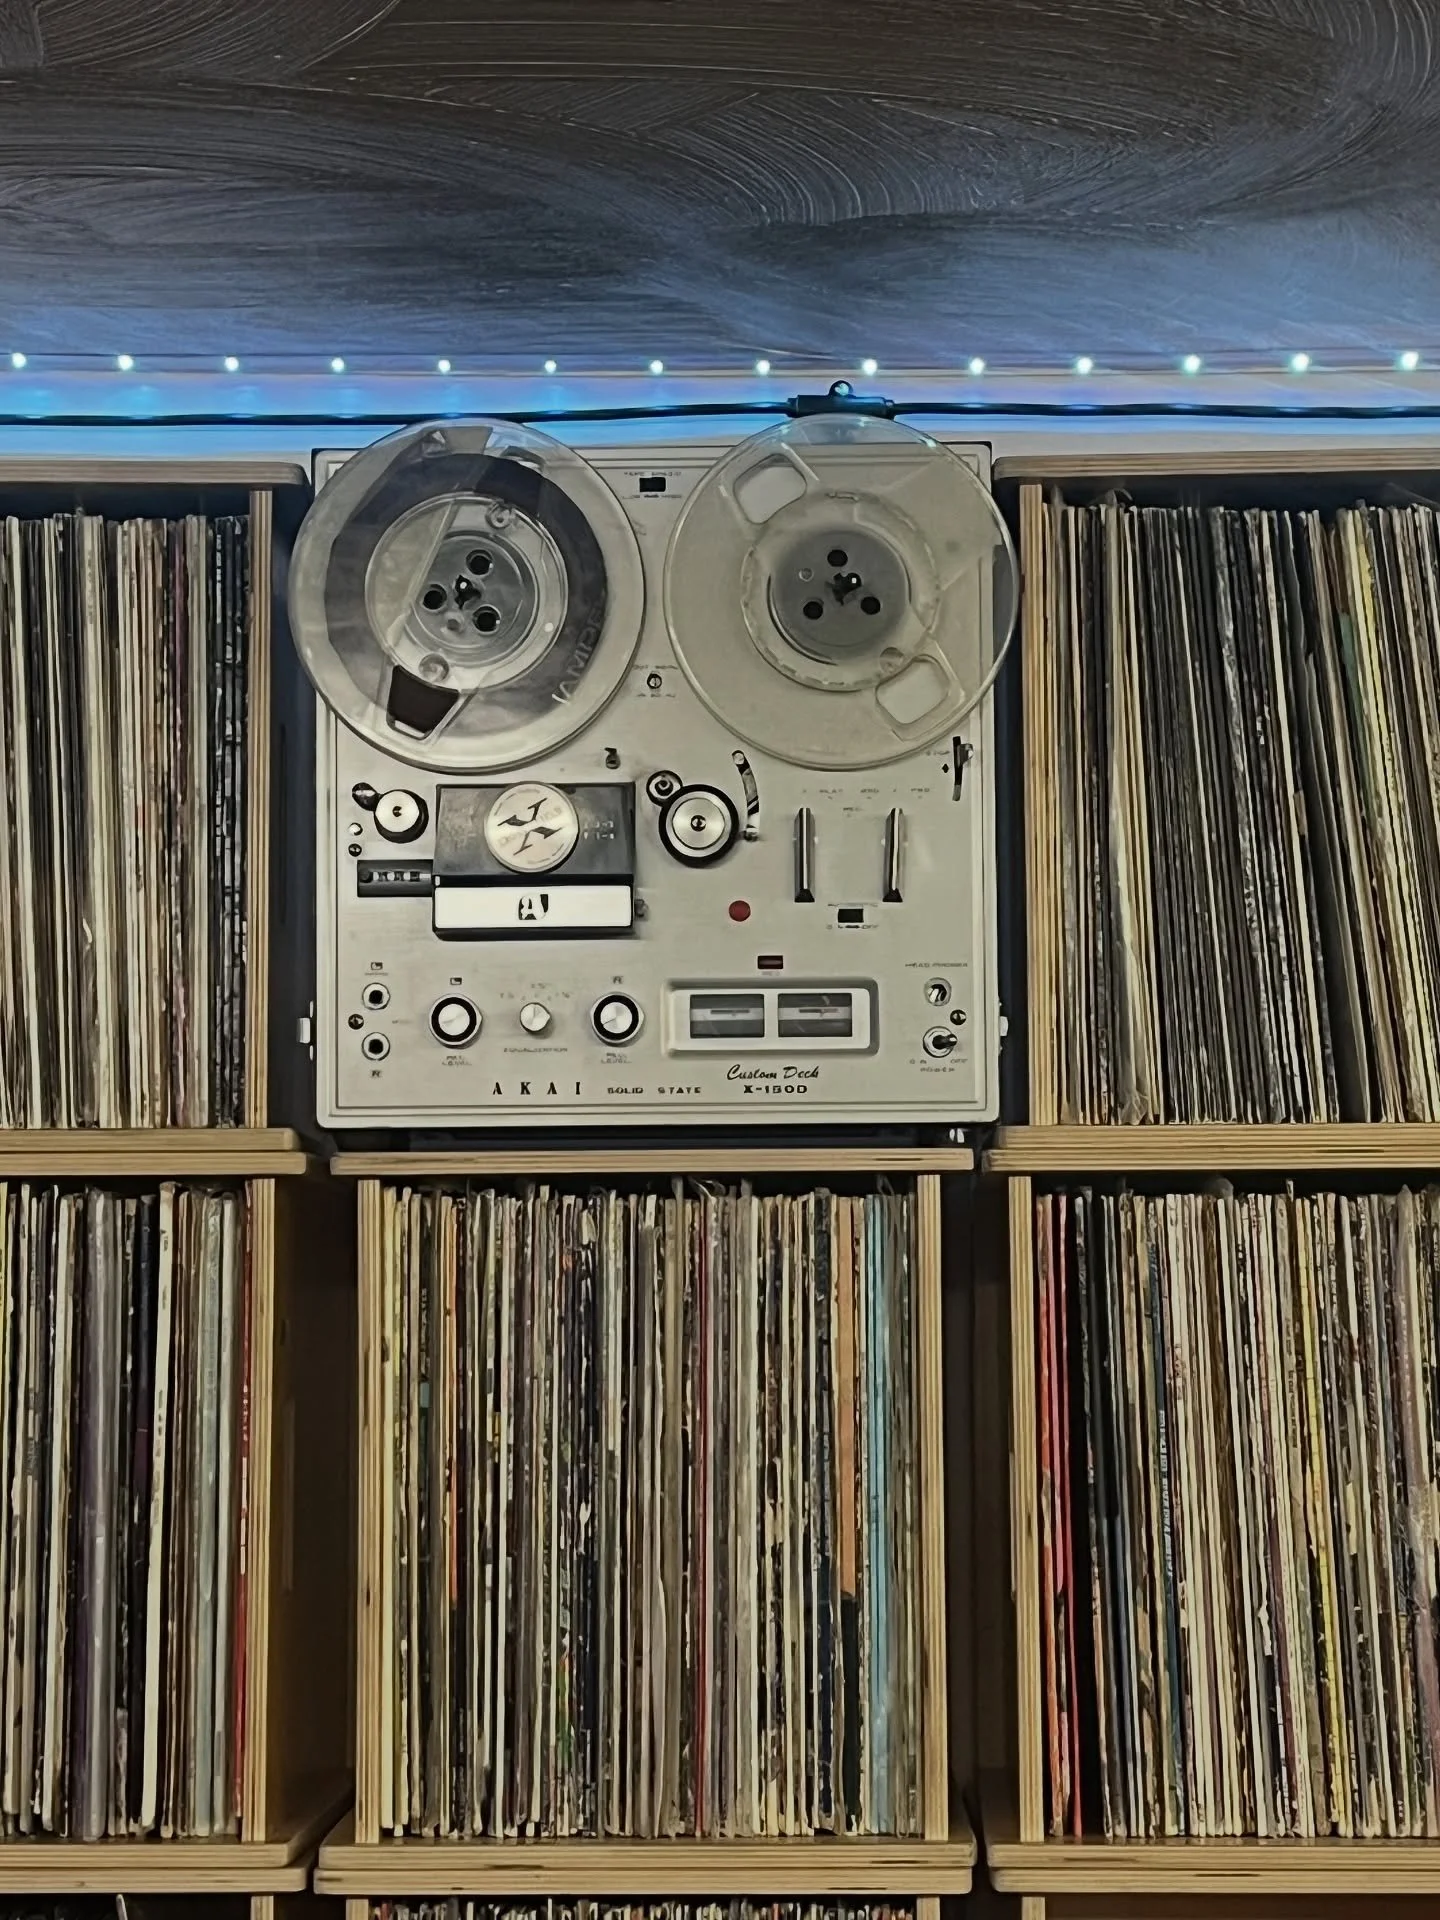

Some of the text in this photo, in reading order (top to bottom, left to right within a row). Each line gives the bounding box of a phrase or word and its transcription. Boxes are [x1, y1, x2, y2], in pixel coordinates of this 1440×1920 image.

[727, 1064, 819, 1081] Custom Deck
[492, 1081, 581, 1095] AKAI
